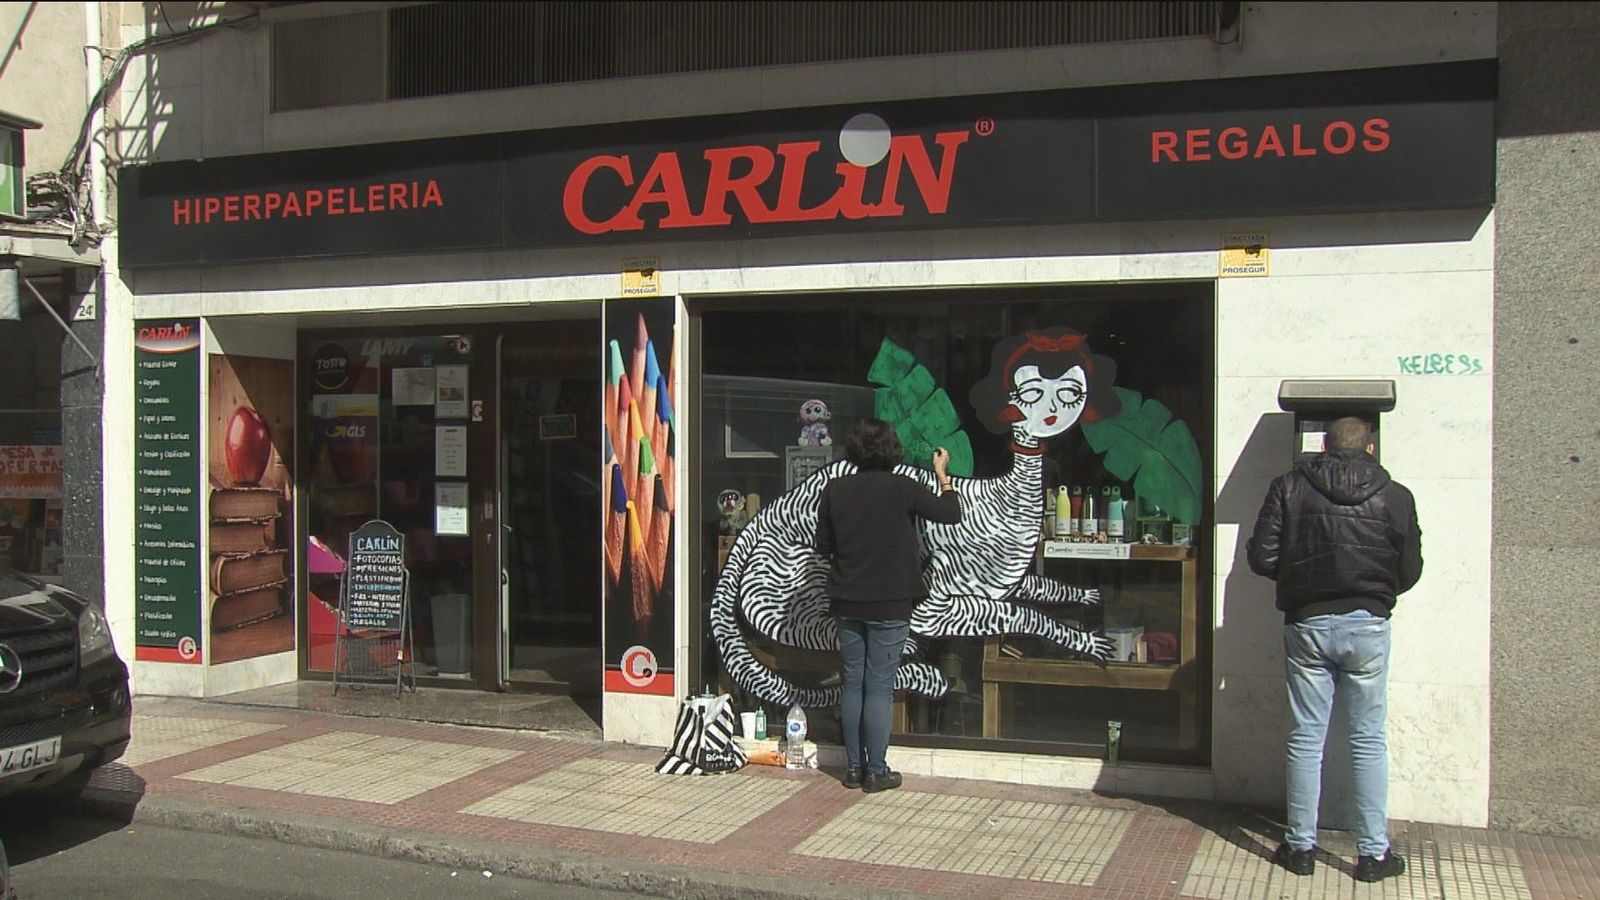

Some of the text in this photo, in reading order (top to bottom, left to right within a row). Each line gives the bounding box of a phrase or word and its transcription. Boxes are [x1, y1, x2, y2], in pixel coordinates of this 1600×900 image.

[1151, 118, 1391, 163] REGALOS
[172, 180, 444, 226] HIPERPAPELERIA
[624, 287, 657, 295] PROSEGUR
[79, 305, 94, 317] 24
[347, 425, 367, 438] GLS
[21, 741, 57, 768] GLJ
